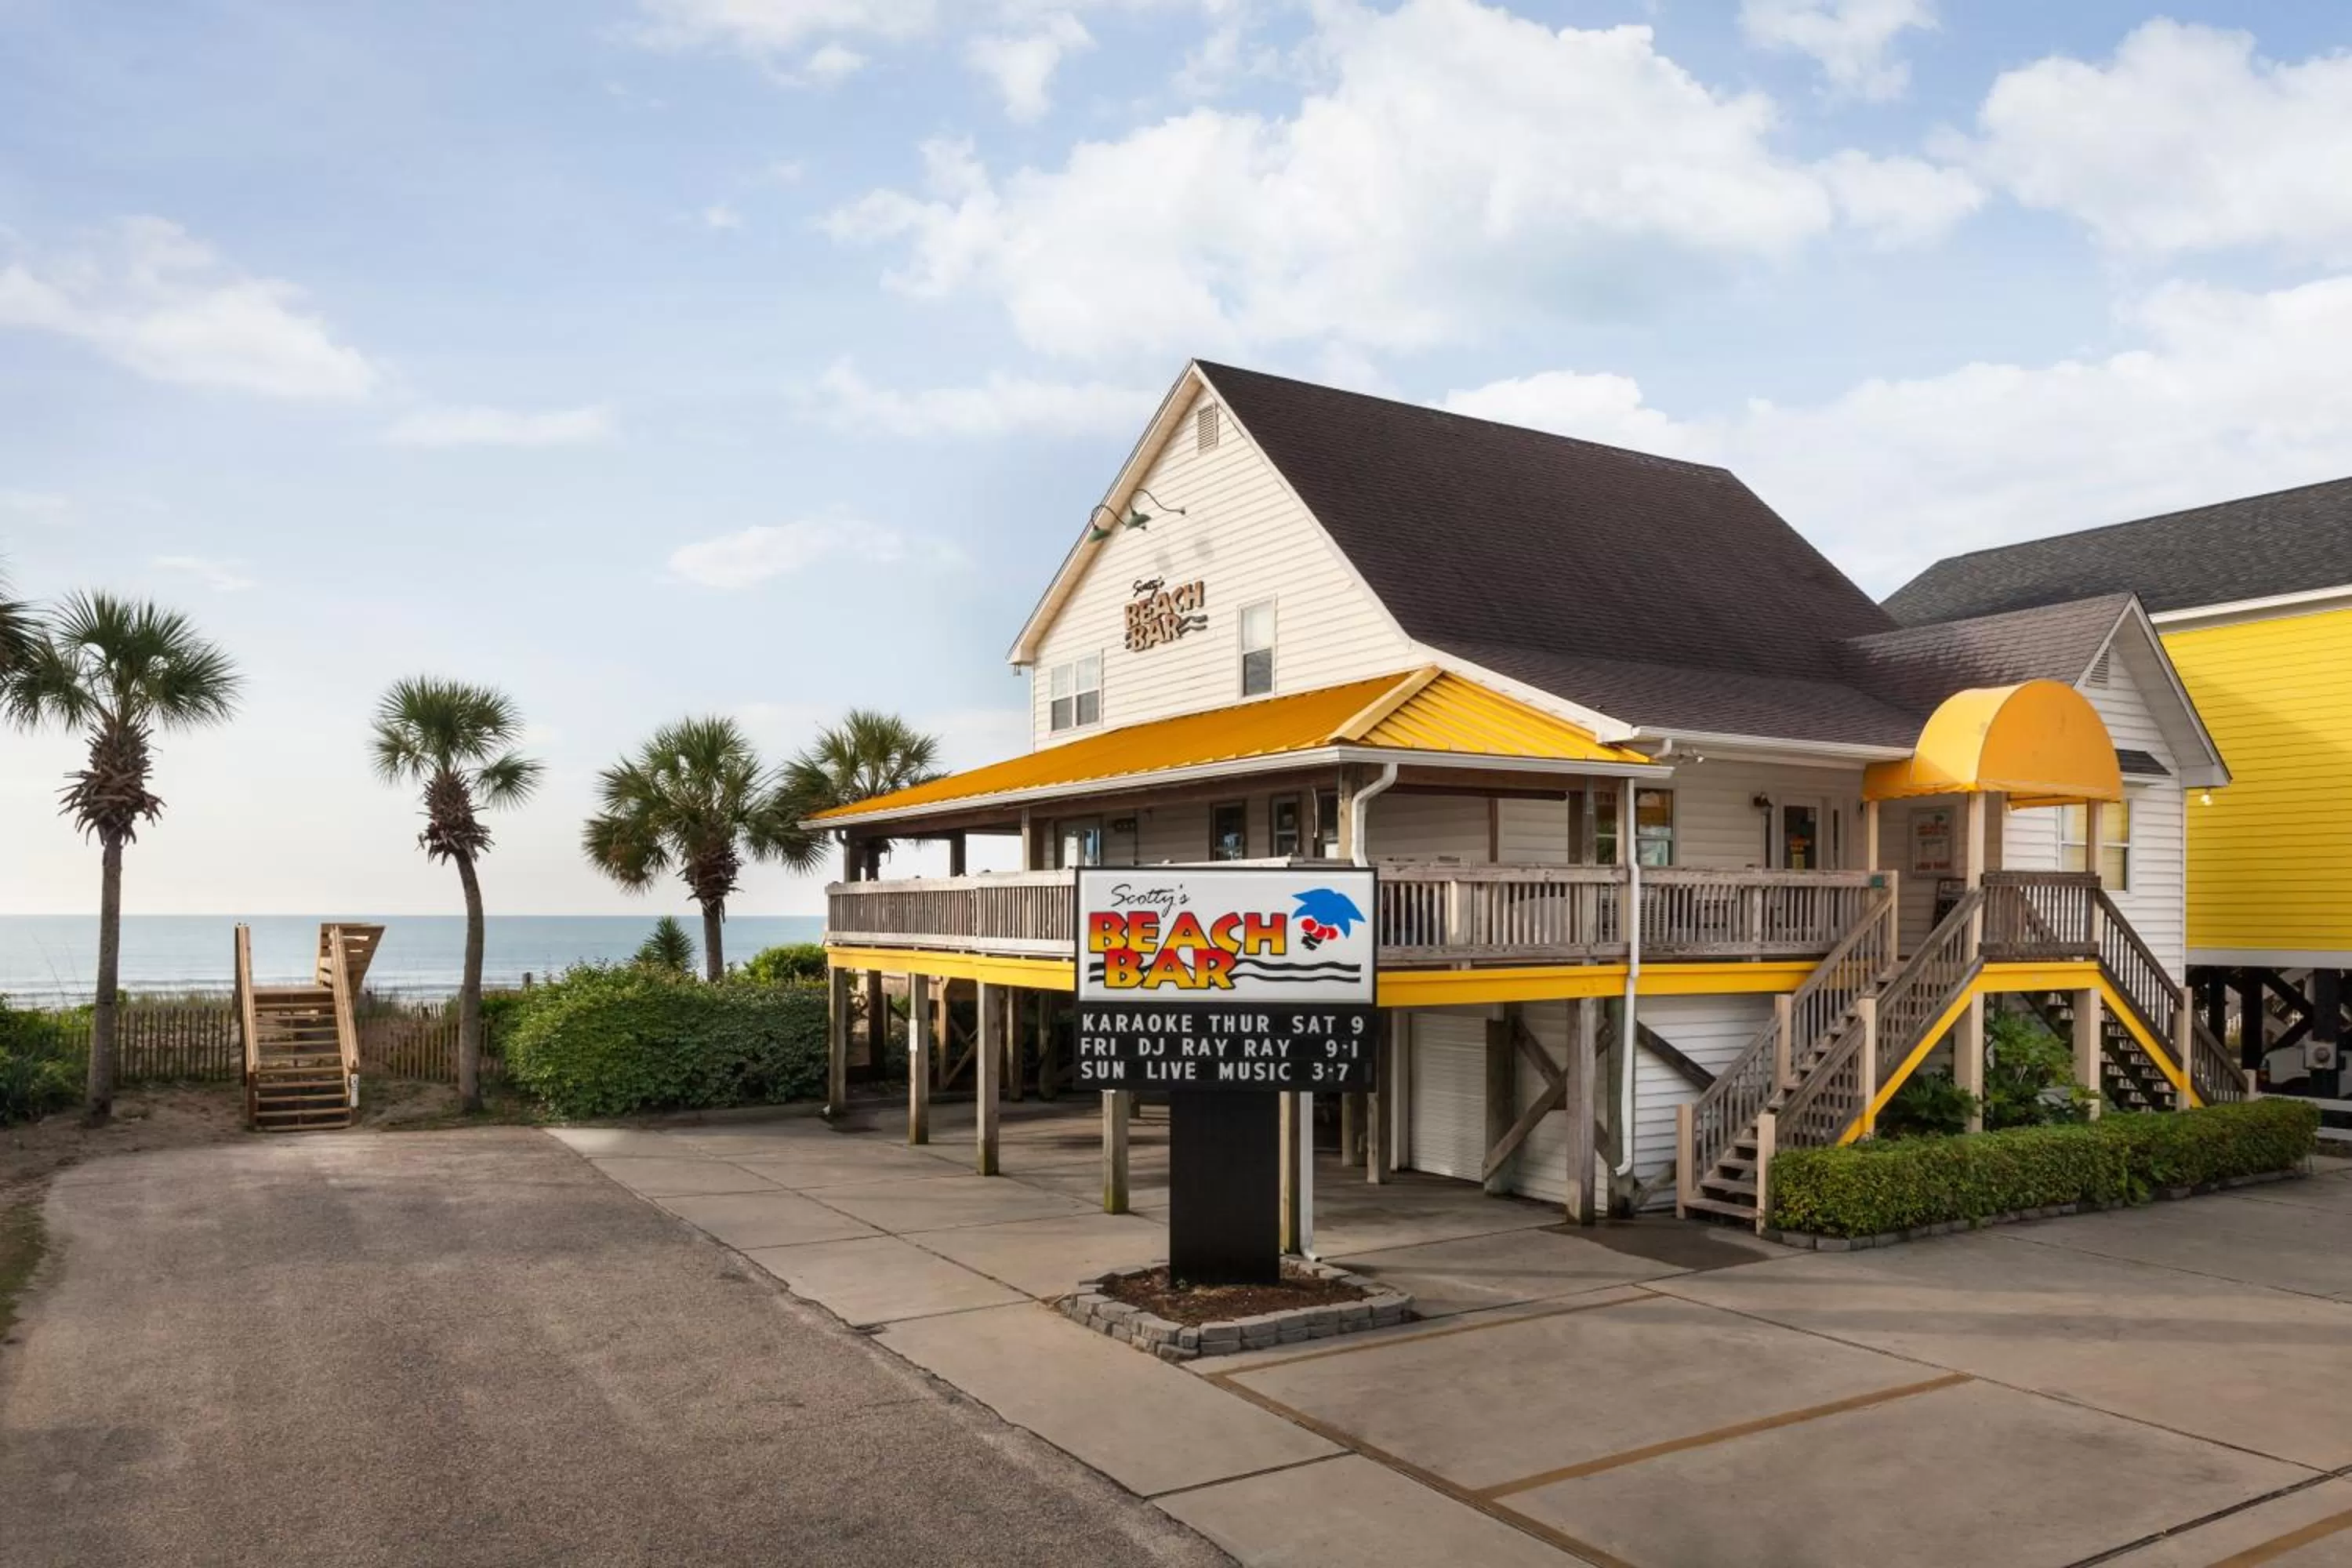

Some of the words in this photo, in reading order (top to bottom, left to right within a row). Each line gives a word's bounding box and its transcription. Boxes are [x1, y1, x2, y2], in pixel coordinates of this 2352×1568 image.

[1124, 581, 1204, 630] BEACH
[1131, 613, 1182, 652] BAR
[1110, 884, 1191, 917] Scotty's
[1088, 911, 1287, 956] BEACH
[1104, 947, 1236, 989] BAR
[1083, 1014, 1192, 1033] KARAOKE
[1208, 1014, 1269, 1033] THUR
[1292, 1015, 1336, 1034] SAT
[1351, 1015, 1364, 1034] 9
[1080, 1037, 1116, 1056] FRI
[1138, 1037, 1165, 1056] DJ
[1181, 1037, 1228, 1057] RAY
[1244, 1038, 1290, 1058] RAY
[1081, 1061, 1125, 1080] SUN
[1147, 1061, 1196, 1080] LIVE
[1218, 1062, 1291, 1081] MUSIC
[1312, 1062, 1349, 1082] 3-7
